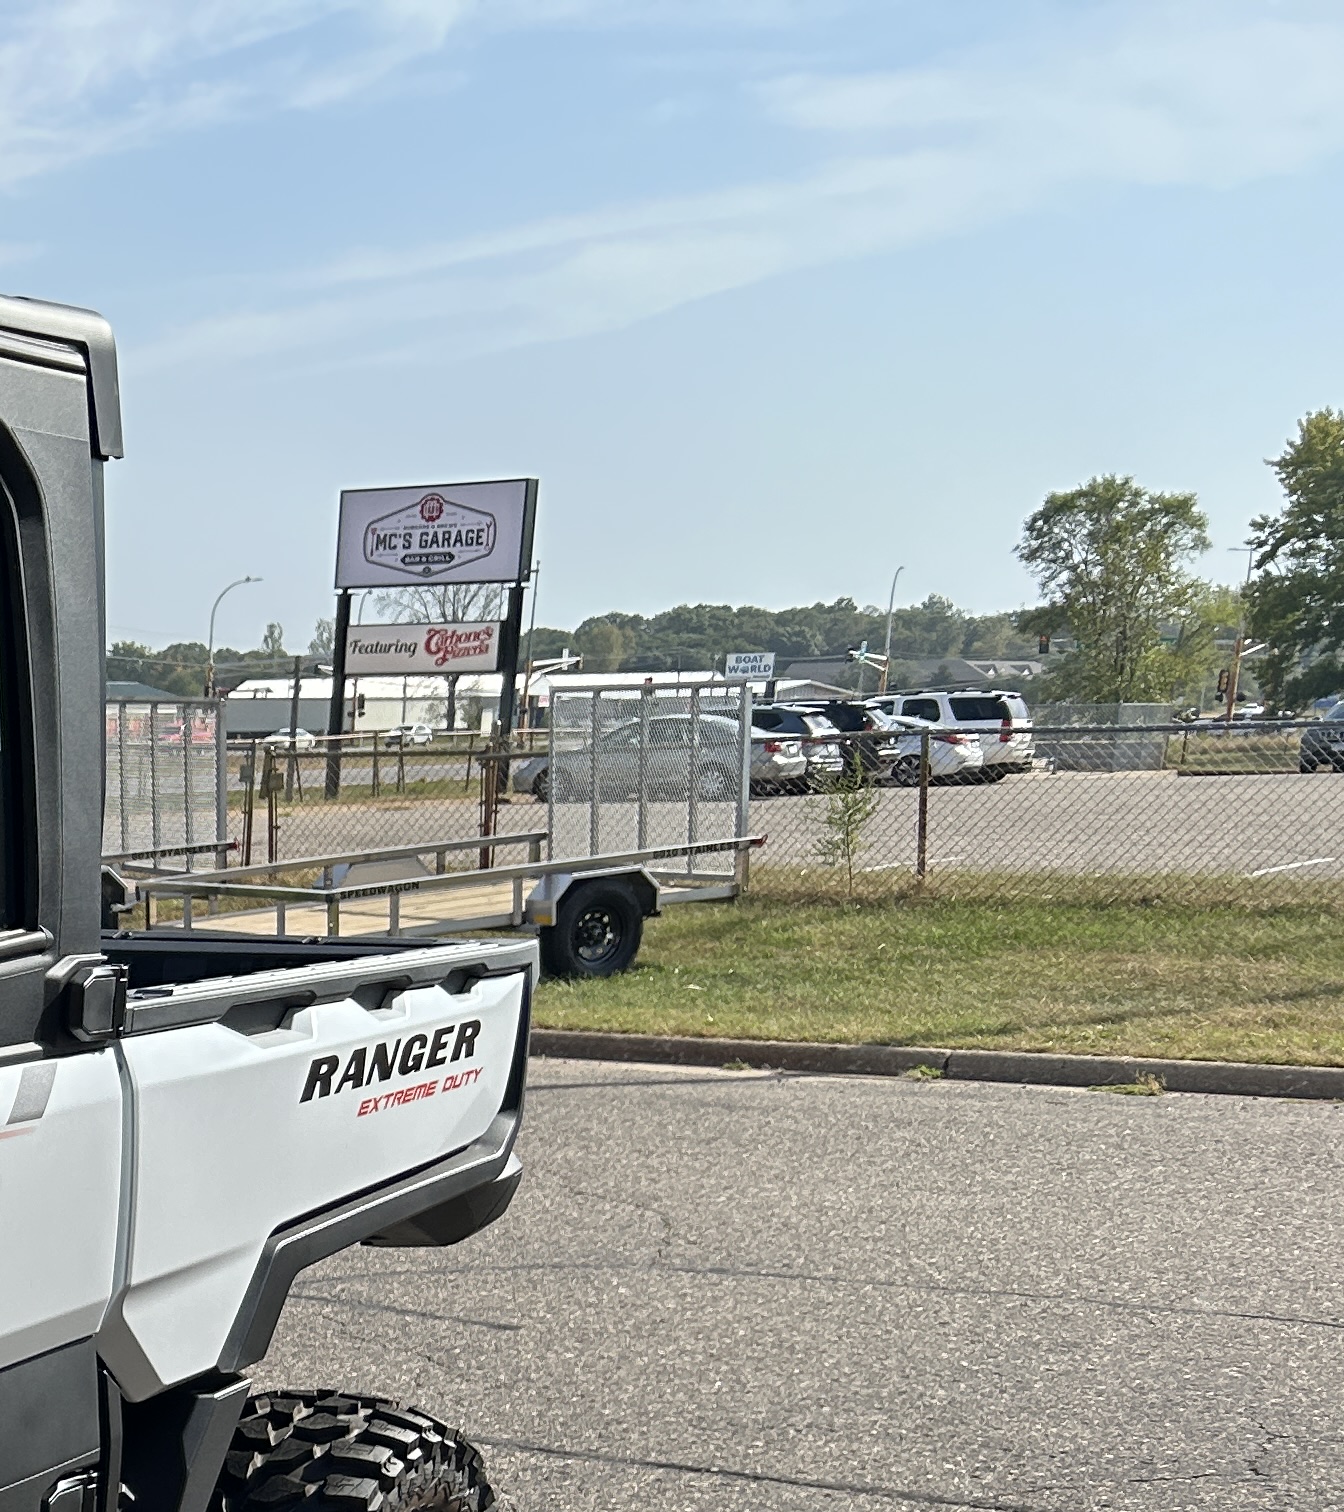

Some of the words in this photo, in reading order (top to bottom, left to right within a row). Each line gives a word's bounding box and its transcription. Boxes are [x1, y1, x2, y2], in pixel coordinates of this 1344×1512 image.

[375, 531, 413, 551] MC'S
[419, 528, 485, 549] GARAGE
[350, 638, 418, 658] Featuring
[735, 655, 765, 664] BOAT
[340, 881, 420, 900] SPEEDWAGON
[299, 1019, 481, 1104] RANGER
[357, 1080, 440, 1117] EXTREME
[441, 1067, 484, 1094] DUTY
